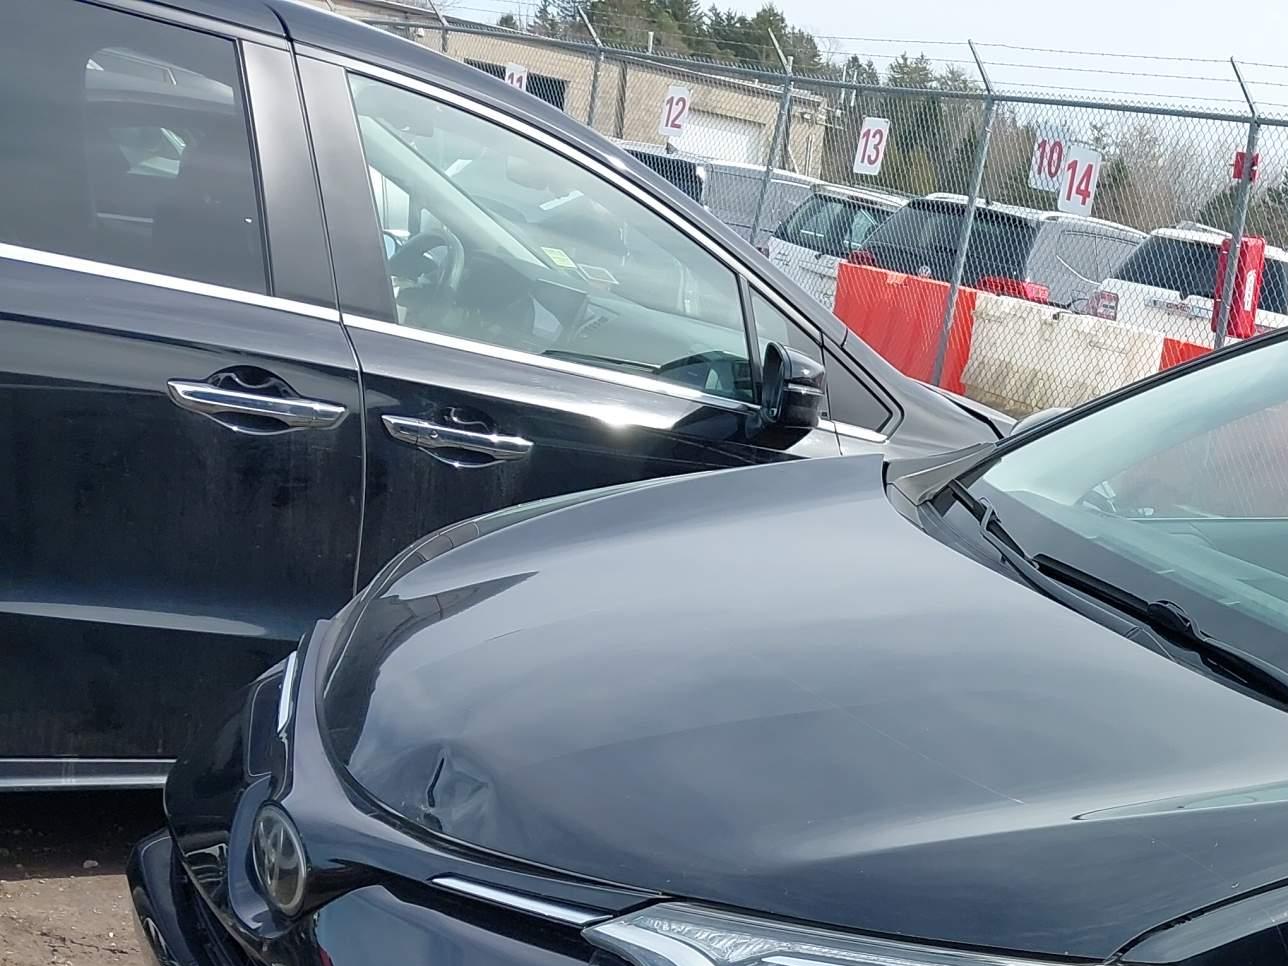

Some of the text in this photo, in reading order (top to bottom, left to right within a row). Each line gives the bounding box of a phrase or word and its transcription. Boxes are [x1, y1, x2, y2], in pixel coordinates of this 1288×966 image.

[664, 96, 687, 129] 12
[860, 129, 883, 165] 13
[1037, 139, 1063, 178] 10
[1065, 160, 1094, 206] 14
